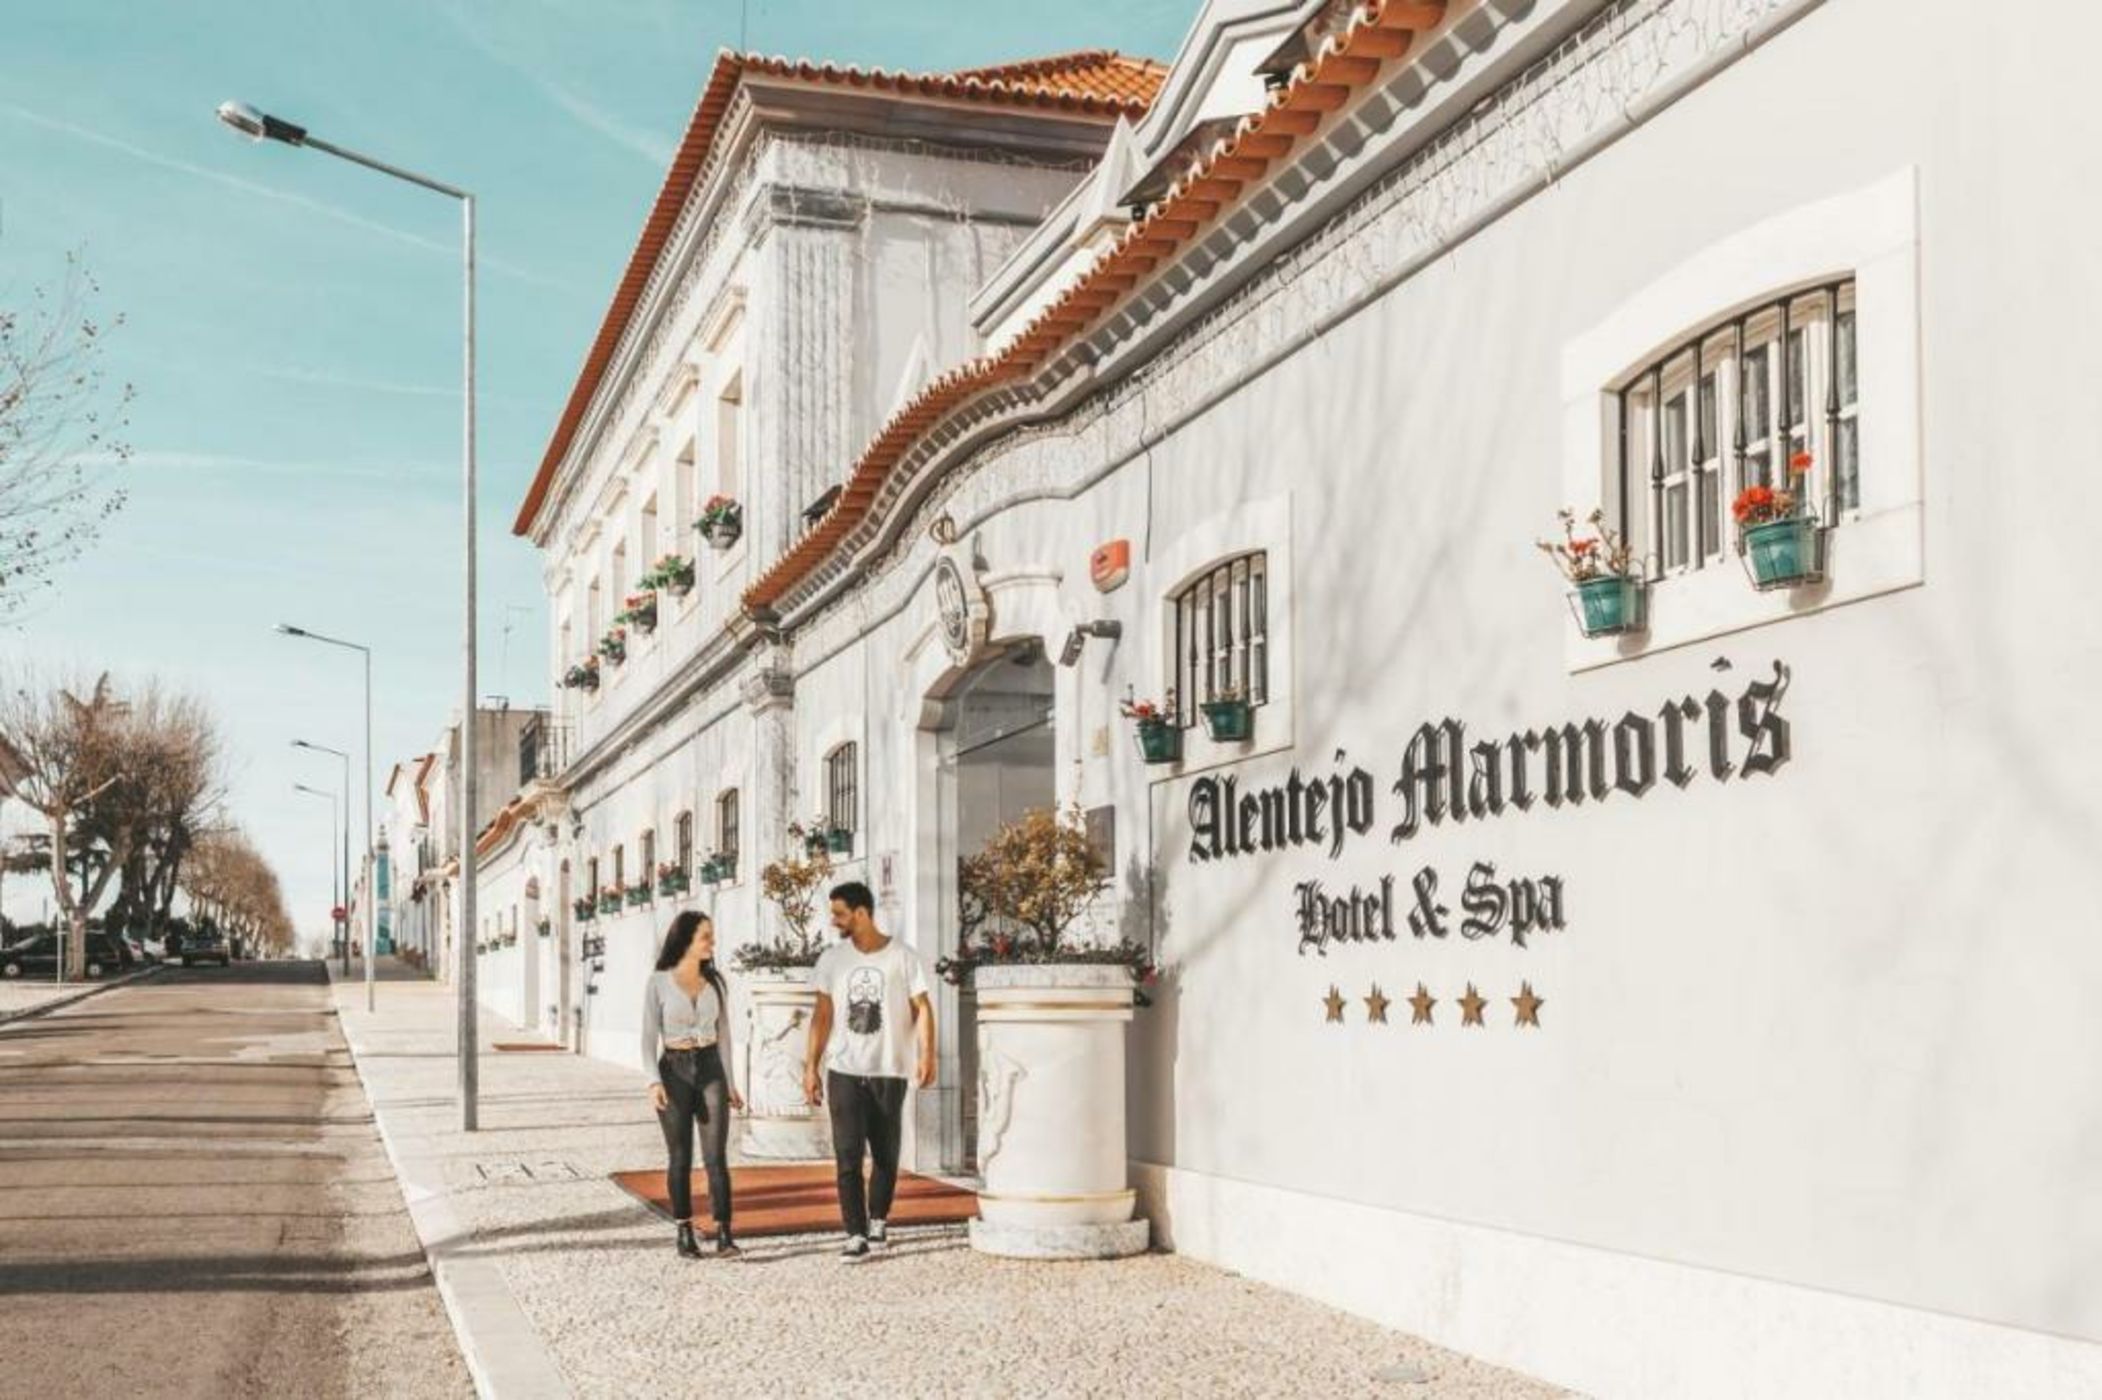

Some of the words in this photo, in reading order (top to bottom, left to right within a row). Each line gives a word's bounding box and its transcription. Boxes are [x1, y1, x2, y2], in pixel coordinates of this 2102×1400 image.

[1188, 748, 1374, 862] Alentejo
[1391, 655, 1791, 845] Marmoris
[1295, 874, 1396, 957] Hotel
[1407, 866, 1448, 938] &
[1460, 861, 1566, 947] Spa
